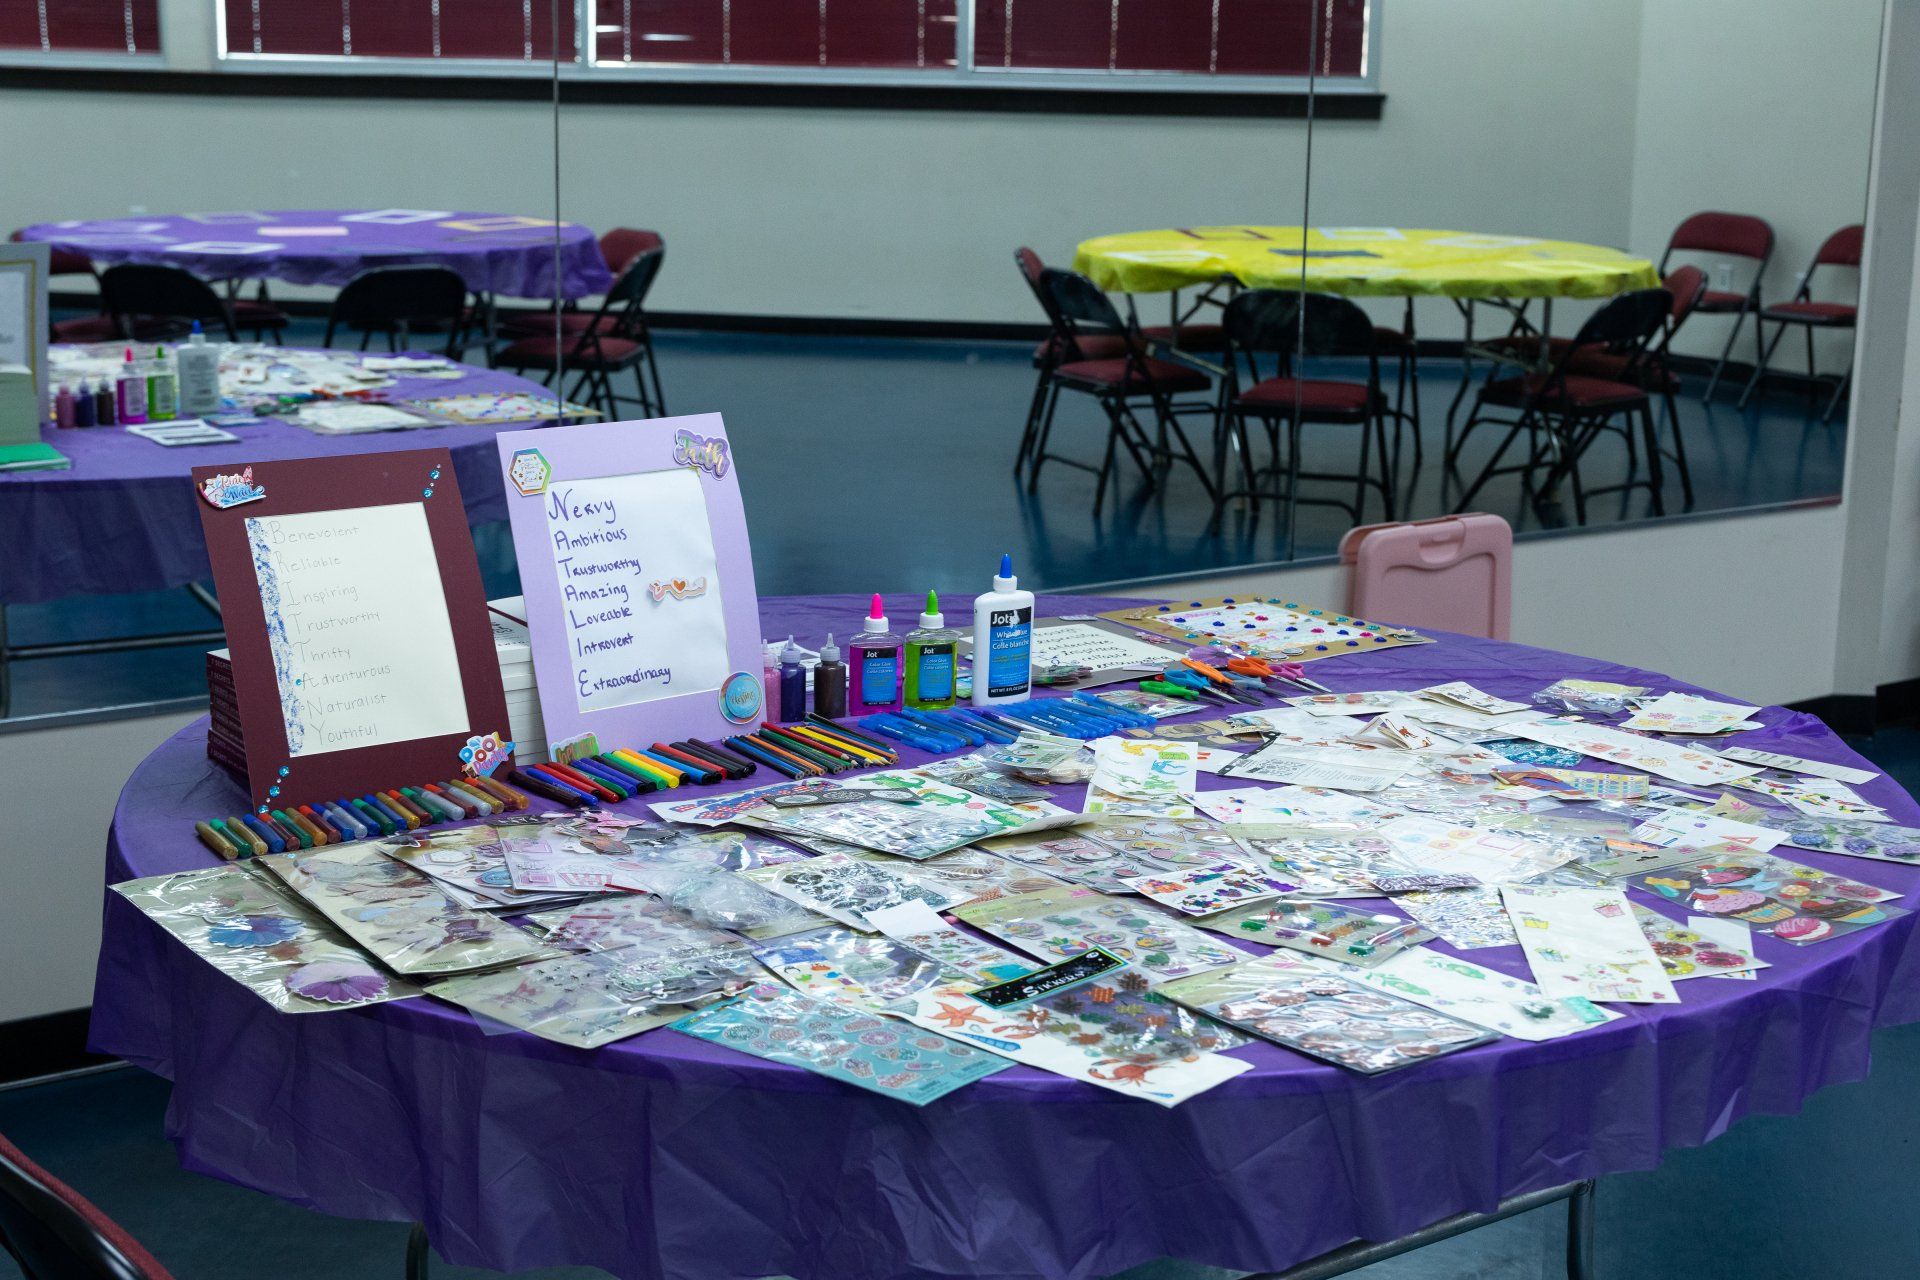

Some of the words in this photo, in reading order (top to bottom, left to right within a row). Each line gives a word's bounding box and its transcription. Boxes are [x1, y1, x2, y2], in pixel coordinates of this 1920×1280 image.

[267, 520, 359, 544] Benevolent
[554, 528, 627, 551] Ambitious
[274, 551, 342, 574] Reliable
[282, 580, 359, 607] Inspiring
[564, 583, 629, 603] Amazing
[287, 610, 381, 635] Trustworthy
[569, 606, 633, 629] Loveable
[992, 613, 1010, 625] Jot
[292, 638, 352, 663] Thrifty
[923, 647, 935, 655] Jot
[301, 664, 391, 690] Adventurous
[306, 693, 387, 719] Naturalist
[310, 719, 378, 746] Youthful
